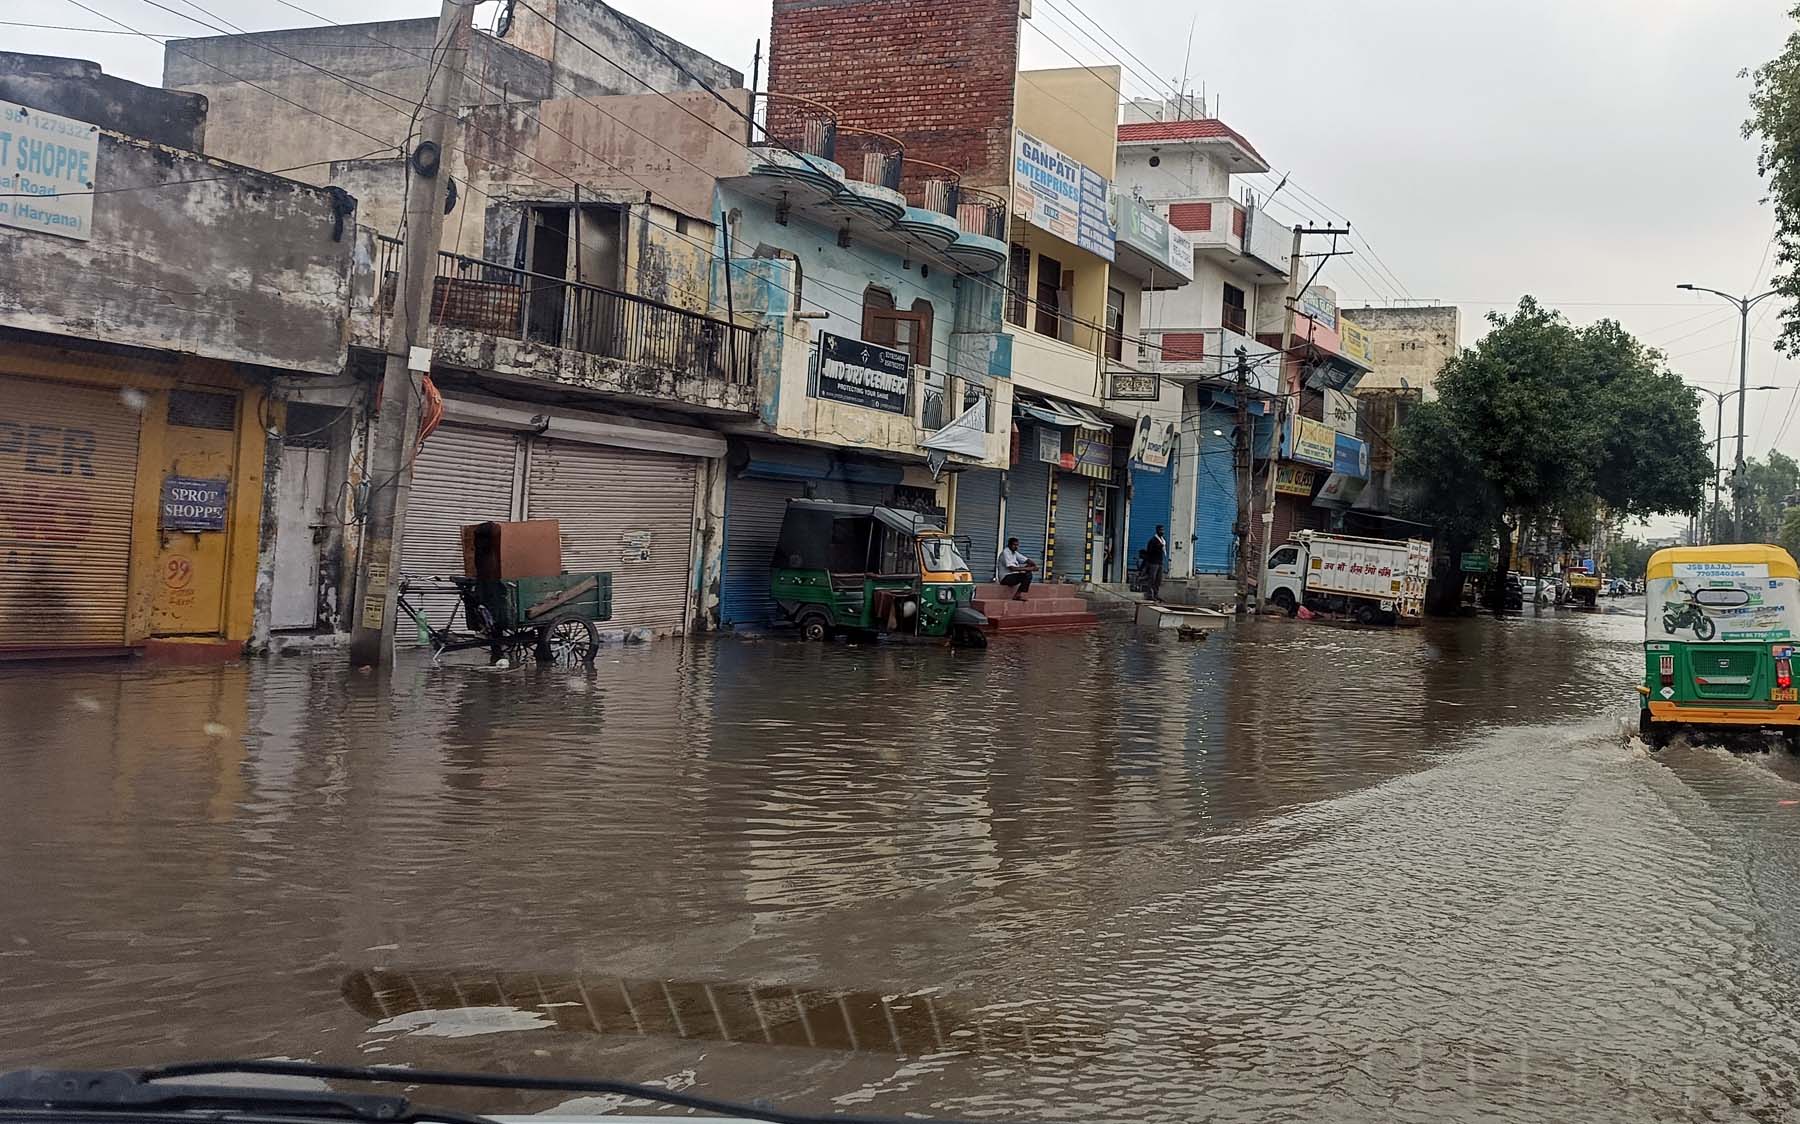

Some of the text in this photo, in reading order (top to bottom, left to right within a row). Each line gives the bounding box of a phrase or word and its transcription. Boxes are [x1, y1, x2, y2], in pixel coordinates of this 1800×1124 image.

[16, 135, 90, 184] SHOPPE
[1022, 142, 1076, 183] GANPATI
[1016, 158, 1080, 202] ENTERPRISES
[13, 202, 82, 230] (Haryana)
[837, 382, 864, 395] PROTECTING
[865, 389, 876, 397] YOUR
[171, 487, 218, 503] SPROT
[165, 504, 223, 519] SHOPPE
